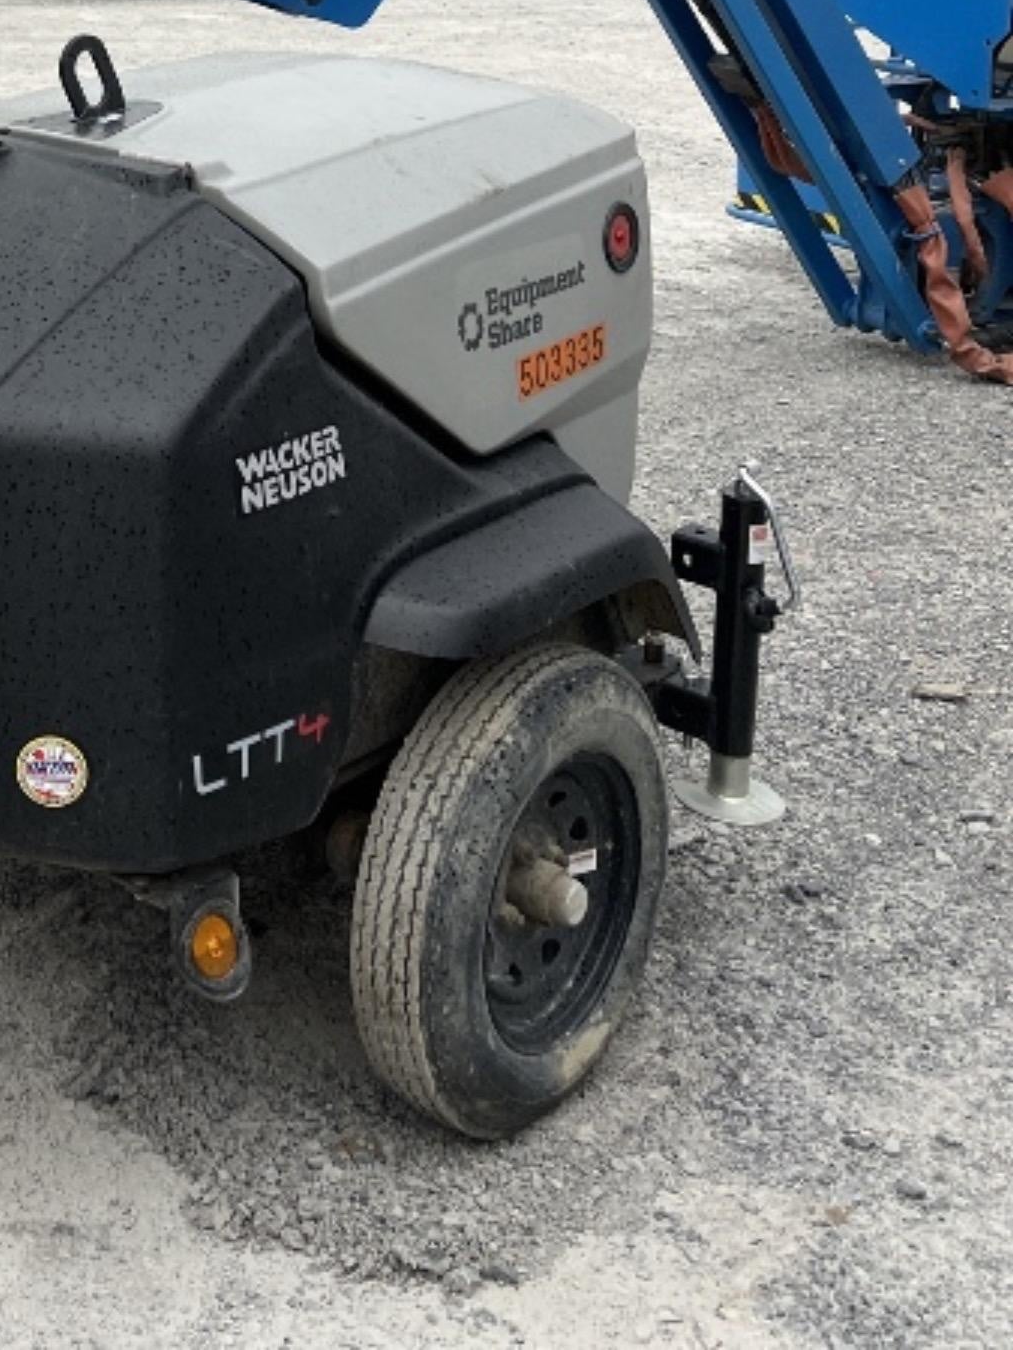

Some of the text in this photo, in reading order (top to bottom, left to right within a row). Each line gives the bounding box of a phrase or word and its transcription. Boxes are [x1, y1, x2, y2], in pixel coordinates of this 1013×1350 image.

[485, 260, 586, 316] Equipment
[488, 311, 543, 350] Share
[519, 325, 605, 397] 503335
[235, 424, 342, 484] WACKER
[240, 452, 346, 515] NEUSON
